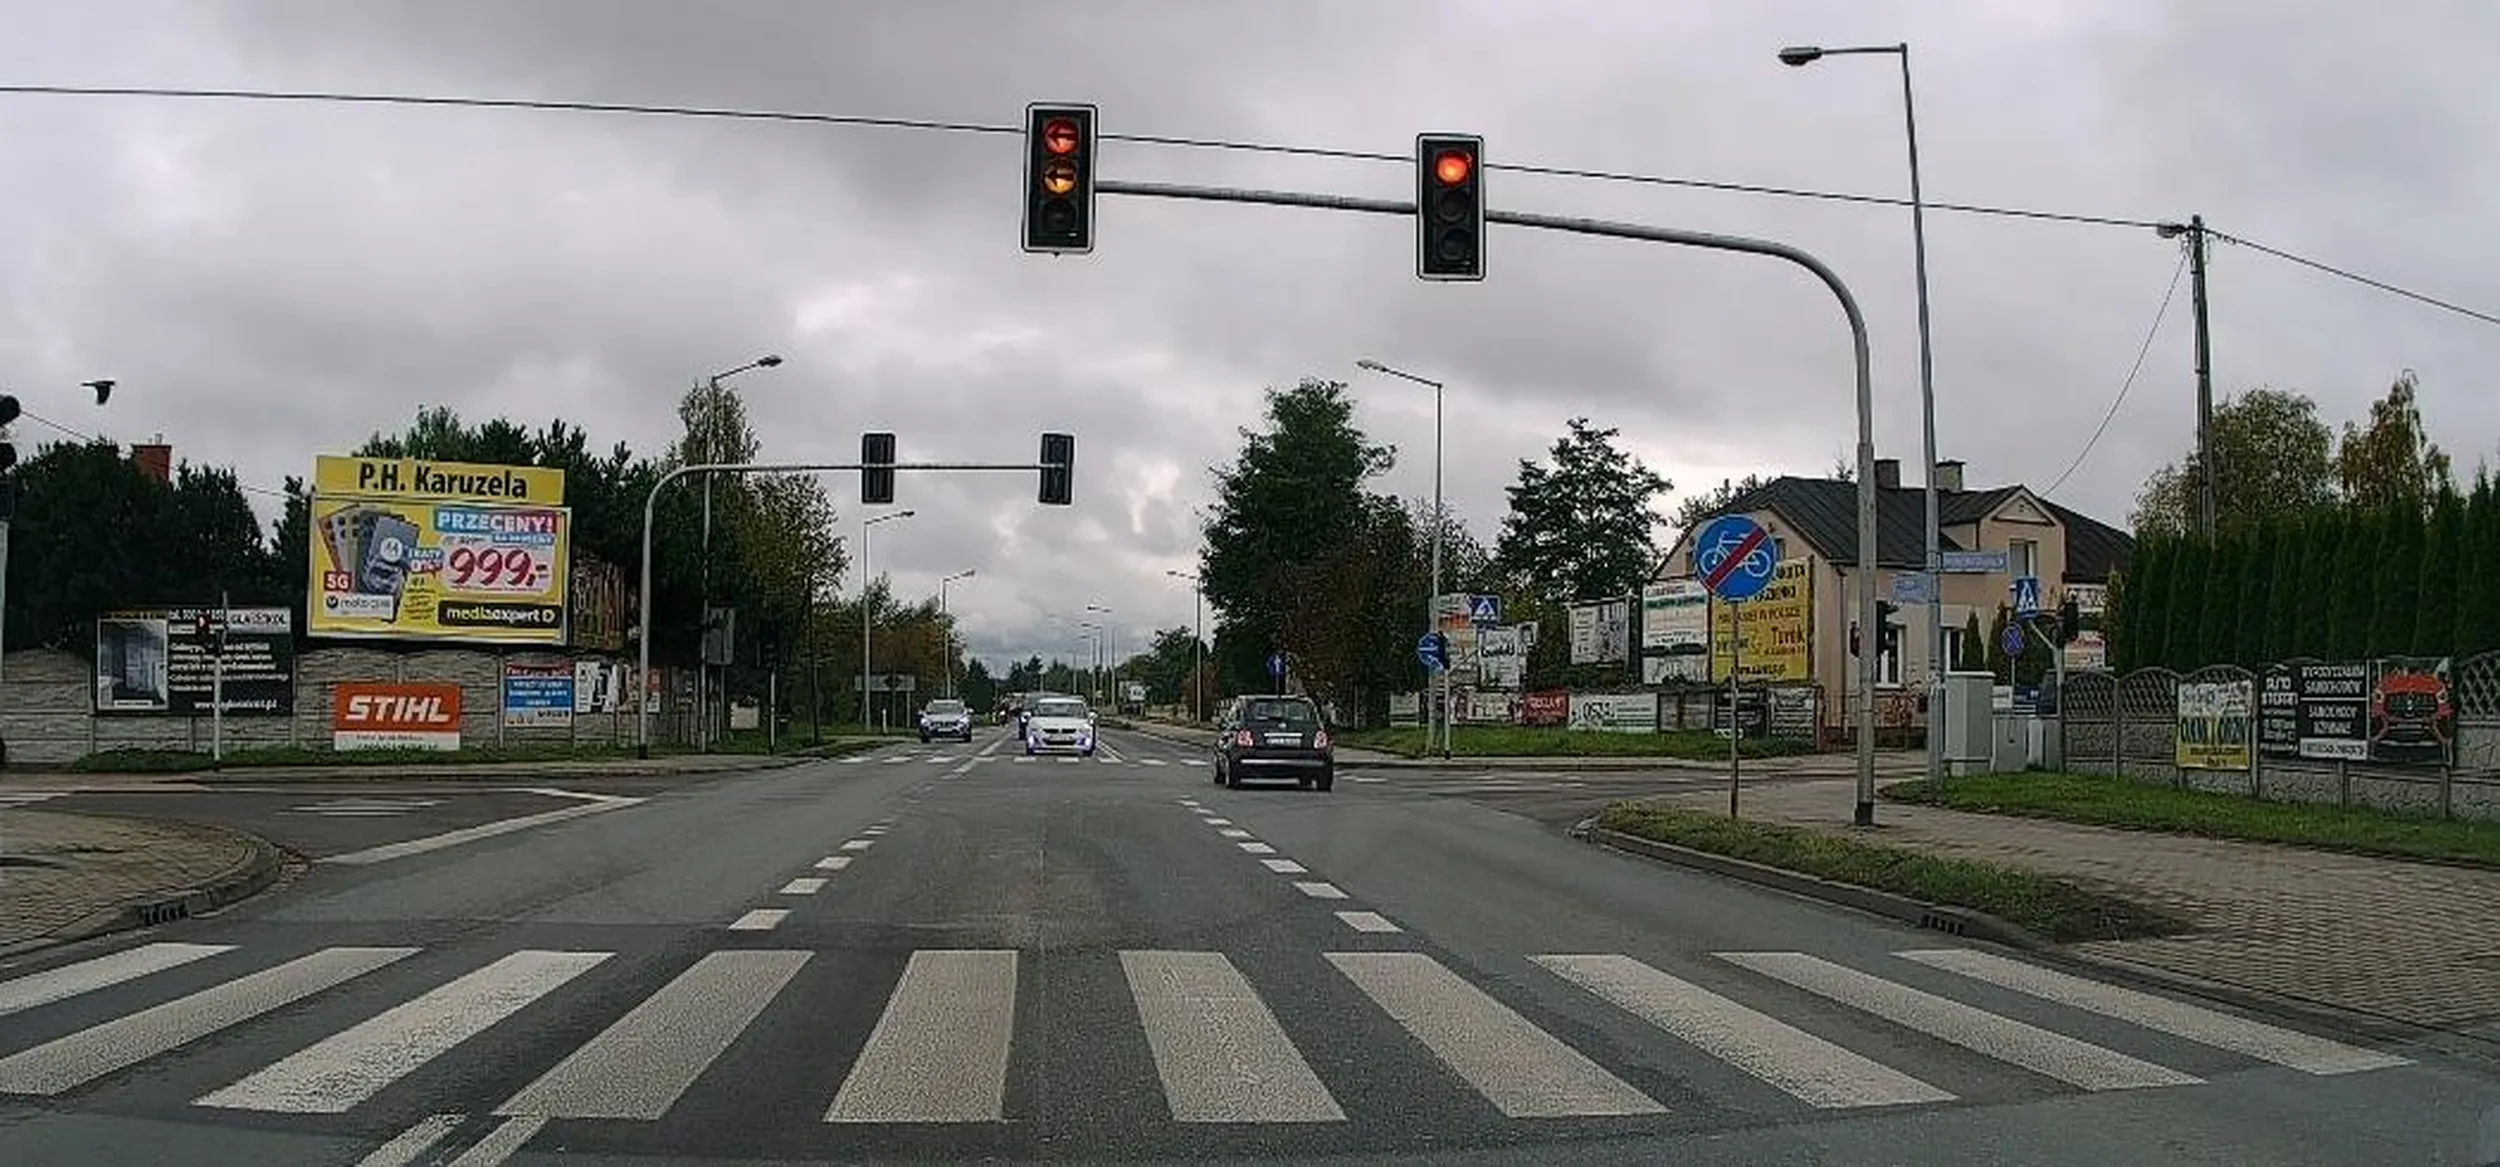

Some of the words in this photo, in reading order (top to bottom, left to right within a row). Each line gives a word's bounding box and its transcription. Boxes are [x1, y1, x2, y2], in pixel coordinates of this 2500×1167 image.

[359, 462, 406, 491] P.H.
[414, 466, 528, 499] Karuzela
[437, 511, 553, 533] PRZECENY!
[326, 573, 349, 589] 5G
[446, 606, 539, 623] mediaexpert
[345, 695, 449, 723] STIHL
